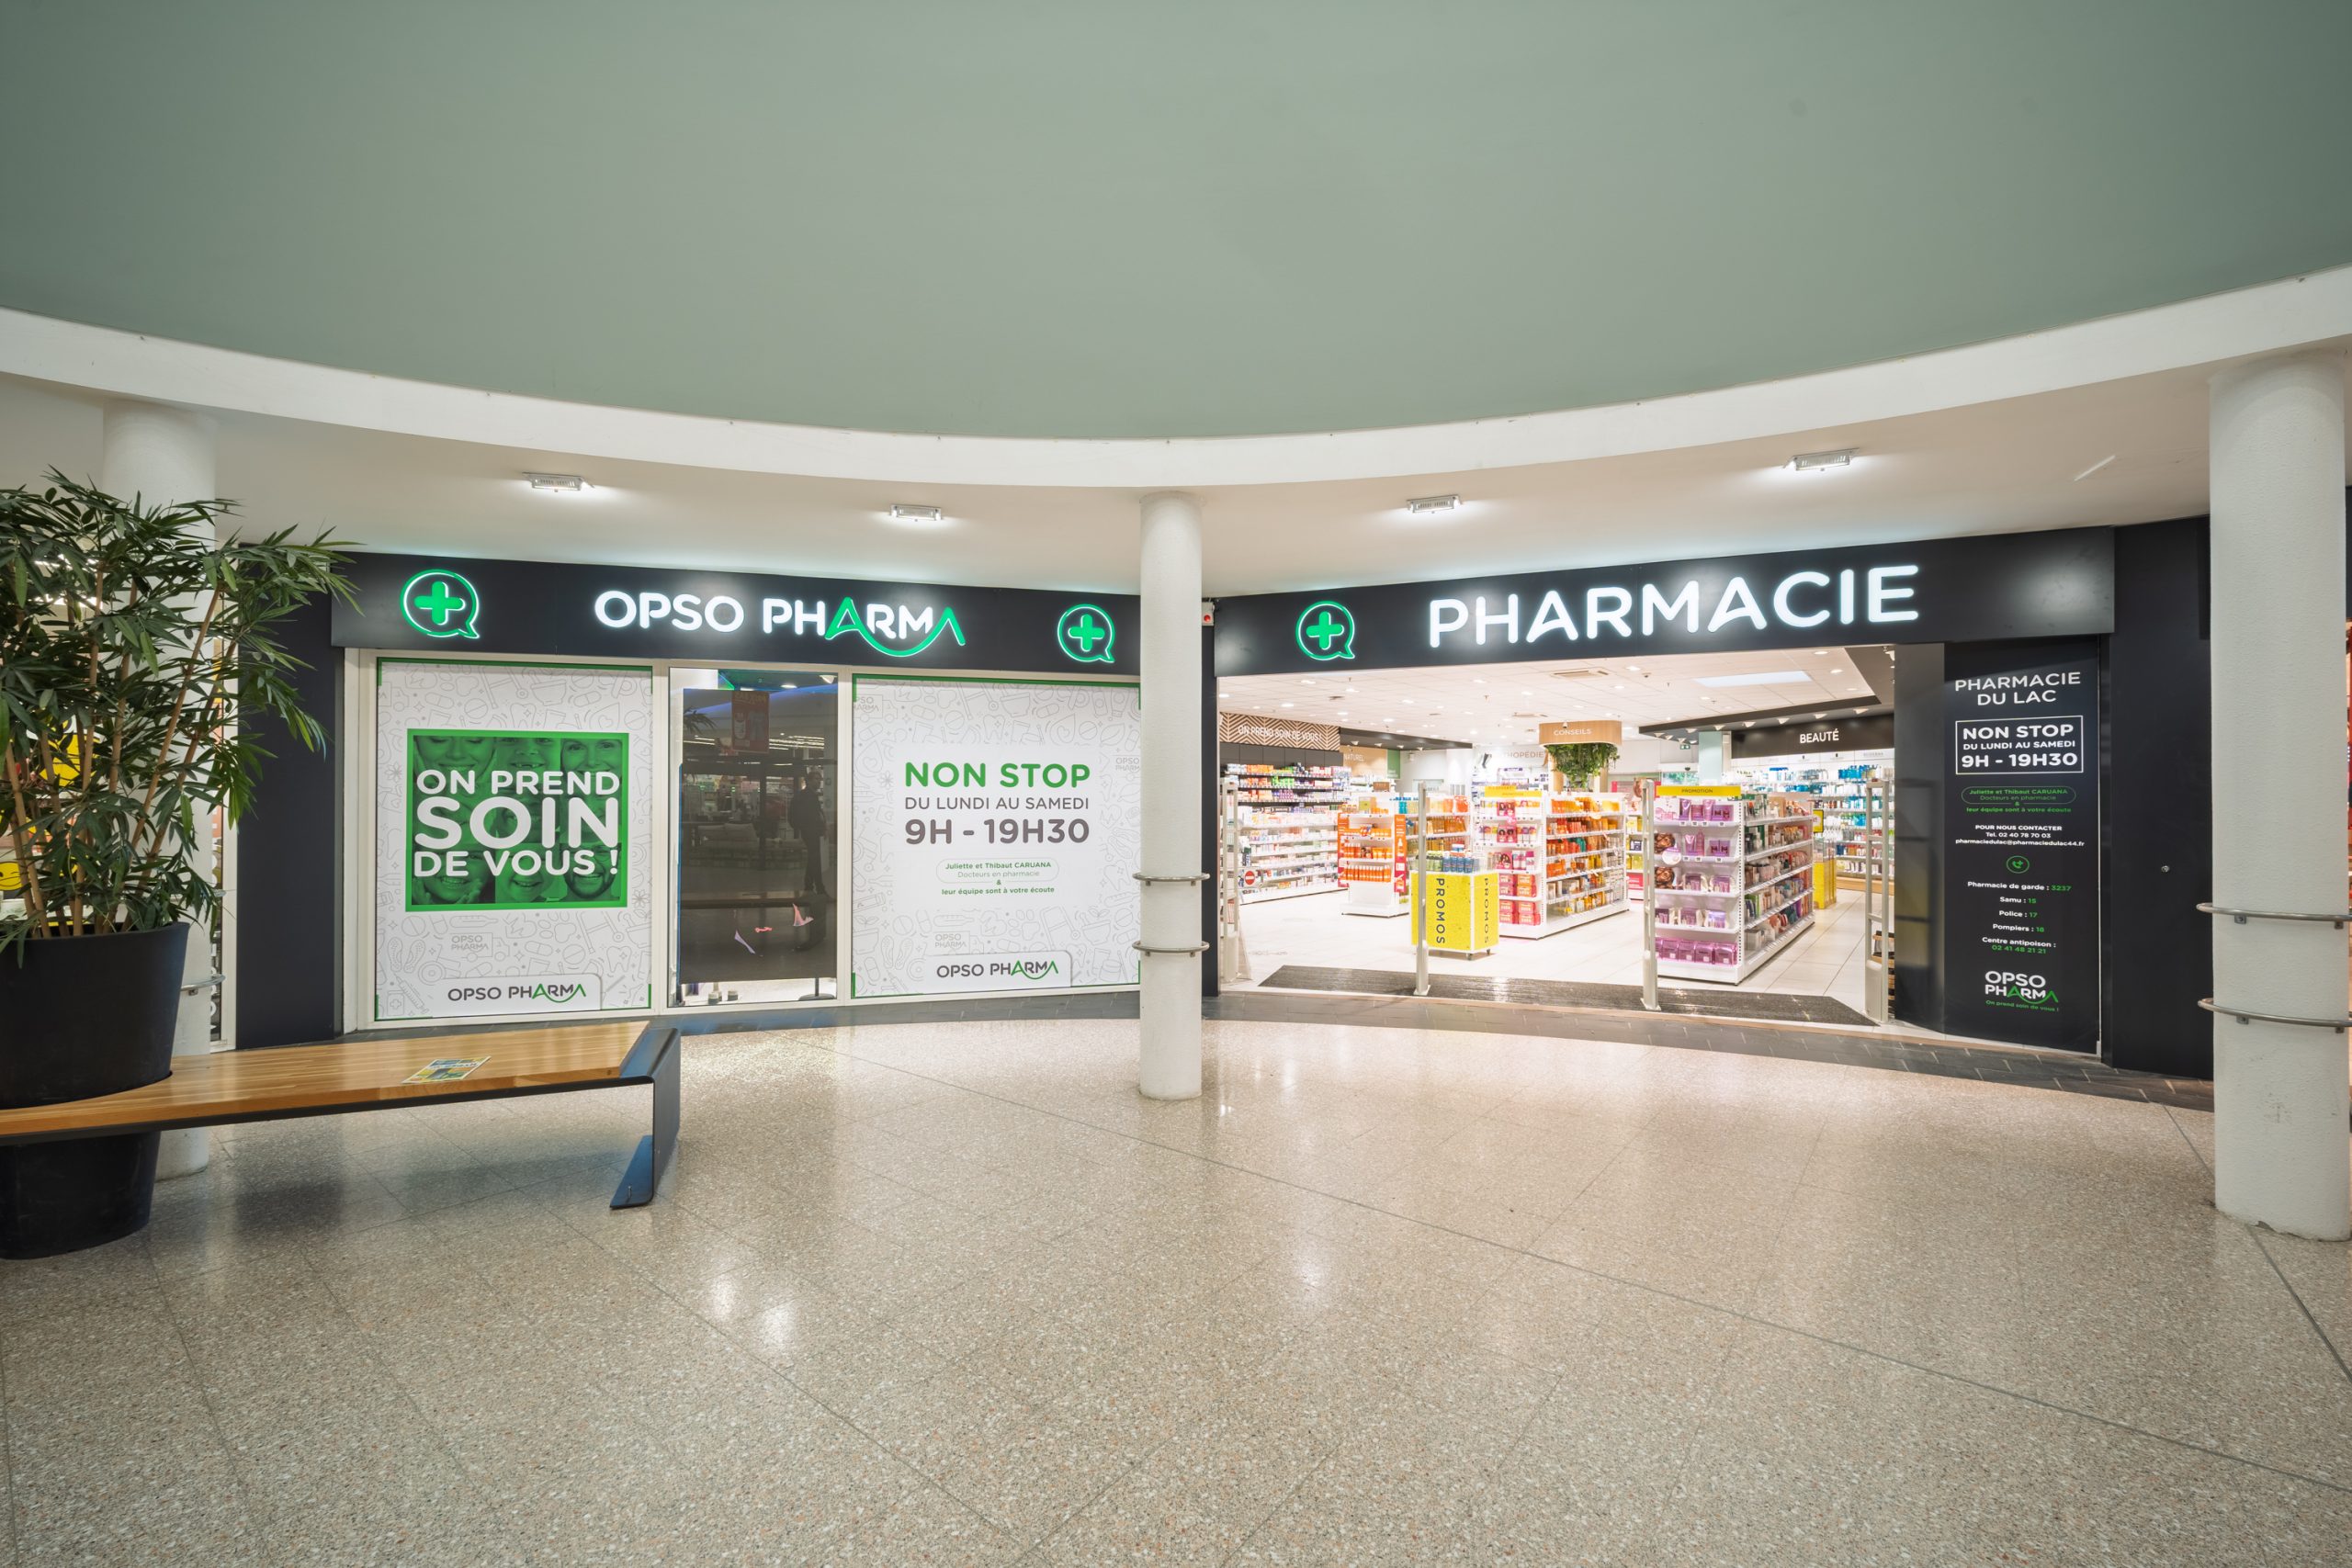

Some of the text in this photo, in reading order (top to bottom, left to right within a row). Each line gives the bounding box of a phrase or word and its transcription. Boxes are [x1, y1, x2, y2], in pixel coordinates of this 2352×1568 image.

[1429, 565, 1918, 648] PHARMACIE
[594, 590, 966, 658] OPSO PHARMA
[1955, 671, 2081, 691] PHARMACIE
[1977, 690, 2056, 705] DU LAC
[1554, 728, 1592, 736] CONSEILS
[1799, 728, 1839, 744] BEAUTÉ
[1962, 724, 2074, 739] NON STOP
[1962, 754, 1989, 768] 9H
[2008, 752, 2077, 767] 19H30
[905, 761, 1091, 788] NON STOP
[1115, 764, 1141, 773] PHARM
[416, 769, 620, 795] ON PREND
[905, 797, 1089, 810] DU LUNDI AU SAMEDI
[414, 796, 618, 850] SOIN
[905, 818, 952, 845] 9H
[983, 818, 1090, 844] 19H30
[1955, 839, 2085, 847] pharmaciedulac@pharmaciedulac44.fr
[414, 849, 618, 877] DE VOUS !
[1002, 870, 1040, 878] pharmacie
[958, 887, 984, 896] équipe
[1967, 881, 2007, 889] Pharmacie
[1435, 878, 1445, 944] PROMOS
[1992, 923, 2030, 932] Pompiers
[451, 935, 483, 943] OPSO
[934, 933, 962, 942] OPSO
[2009, 939, 2052, 948] antipoison
[451, 942, 490, 953] PHARMA
[934, 941, 967, 950] PHARMA
[936, 960, 1058, 980] OPSO PHARMA
[1984, 970, 2046, 988] OPSO
[447, 983, 586, 1003] OPSO PHARMA
[1984, 985, 2059, 1005] PHARMA
